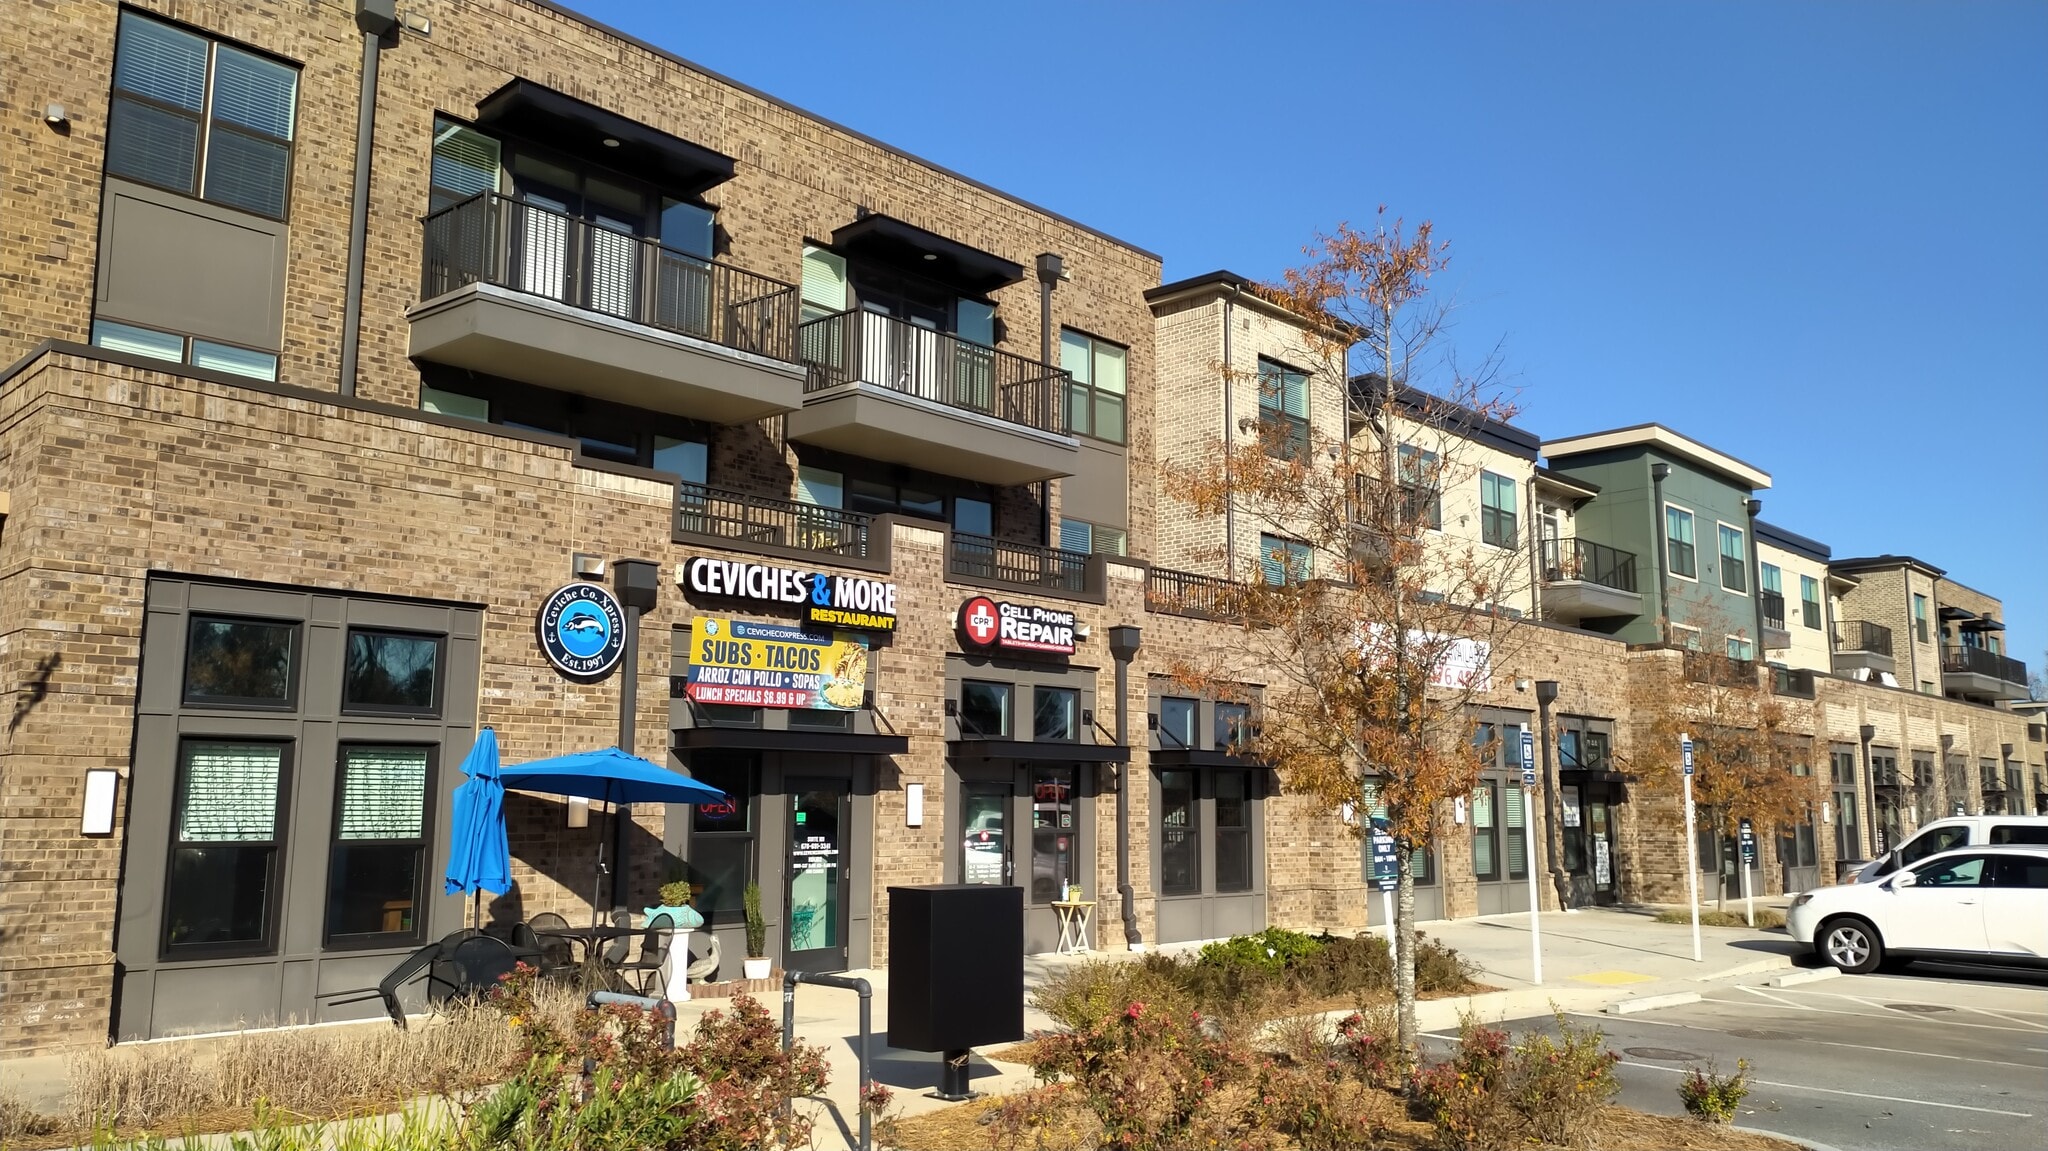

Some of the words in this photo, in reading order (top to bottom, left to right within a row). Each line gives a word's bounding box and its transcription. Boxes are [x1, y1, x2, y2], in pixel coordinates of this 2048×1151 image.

[691, 558, 807, 603] CEVICHES
[812, 573, 831, 606] &
[834, 576, 897, 615] MORE
[546, 590, 577, 627] Ceviche
[580, 587, 598, 600] Co.
[600, 595, 620, 634] Xpress
[810, 607, 895, 630] RESTAURANT
[1000, 603, 1031, 620] CELL
[1033, 608, 1074, 626] PHONE
[746, 627, 825, 643] CEVICHECOXPRESS.COM
[1000, 617, 1074, 646] REPAIR
[701, 639, 752, 666] SUBS
[765, 644, 820, 672] TACOS
[696, 666, 729, 685] ARROZ
[732, 669, 751, 686] CON
[753, 671, 782, 688] POLLO
[792, 674, 820, 690] SOPAS
[695, 686, 723, 701] LUNCH
[724, 689, 762, 704] SPECIALS
[763, 691, 787, 704] $6.99
[788, 693, 794, 705] &
[796, 694, 806, 706] UP
[700, 799, 736, 813] OPEN
